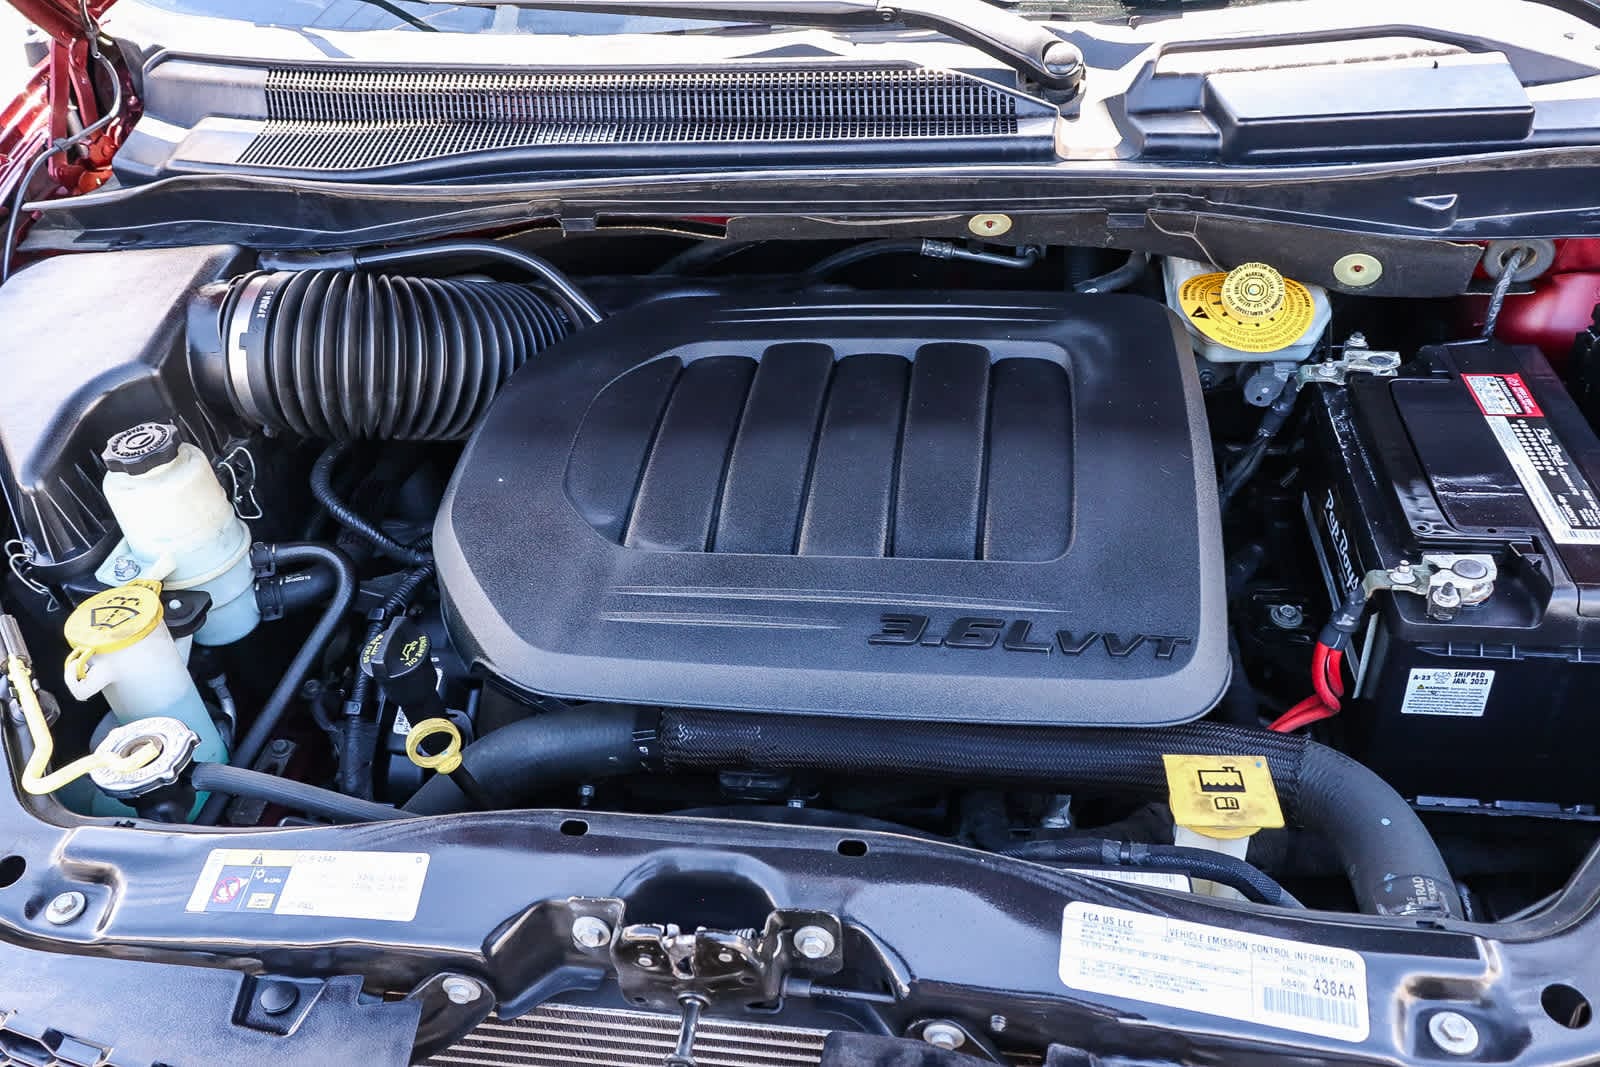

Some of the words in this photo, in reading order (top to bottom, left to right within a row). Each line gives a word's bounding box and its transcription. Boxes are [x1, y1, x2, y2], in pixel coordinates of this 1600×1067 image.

[404, 657, 418, 667] OIL
[1082, 911, 1100, 924] FCA
[1102, 914, 1114, 926] US
[1117, 917, 1134, 929] LLC
[1168, 927, 1204, 943] VEHICLE
[1207, 935, 1249, 951] EMISSION
[1251, 943, 1291, 959] CONTROL
[1294, 950, 1355, 969] INFORMATION
[1313, 976, 1356, 1000] 438AA
